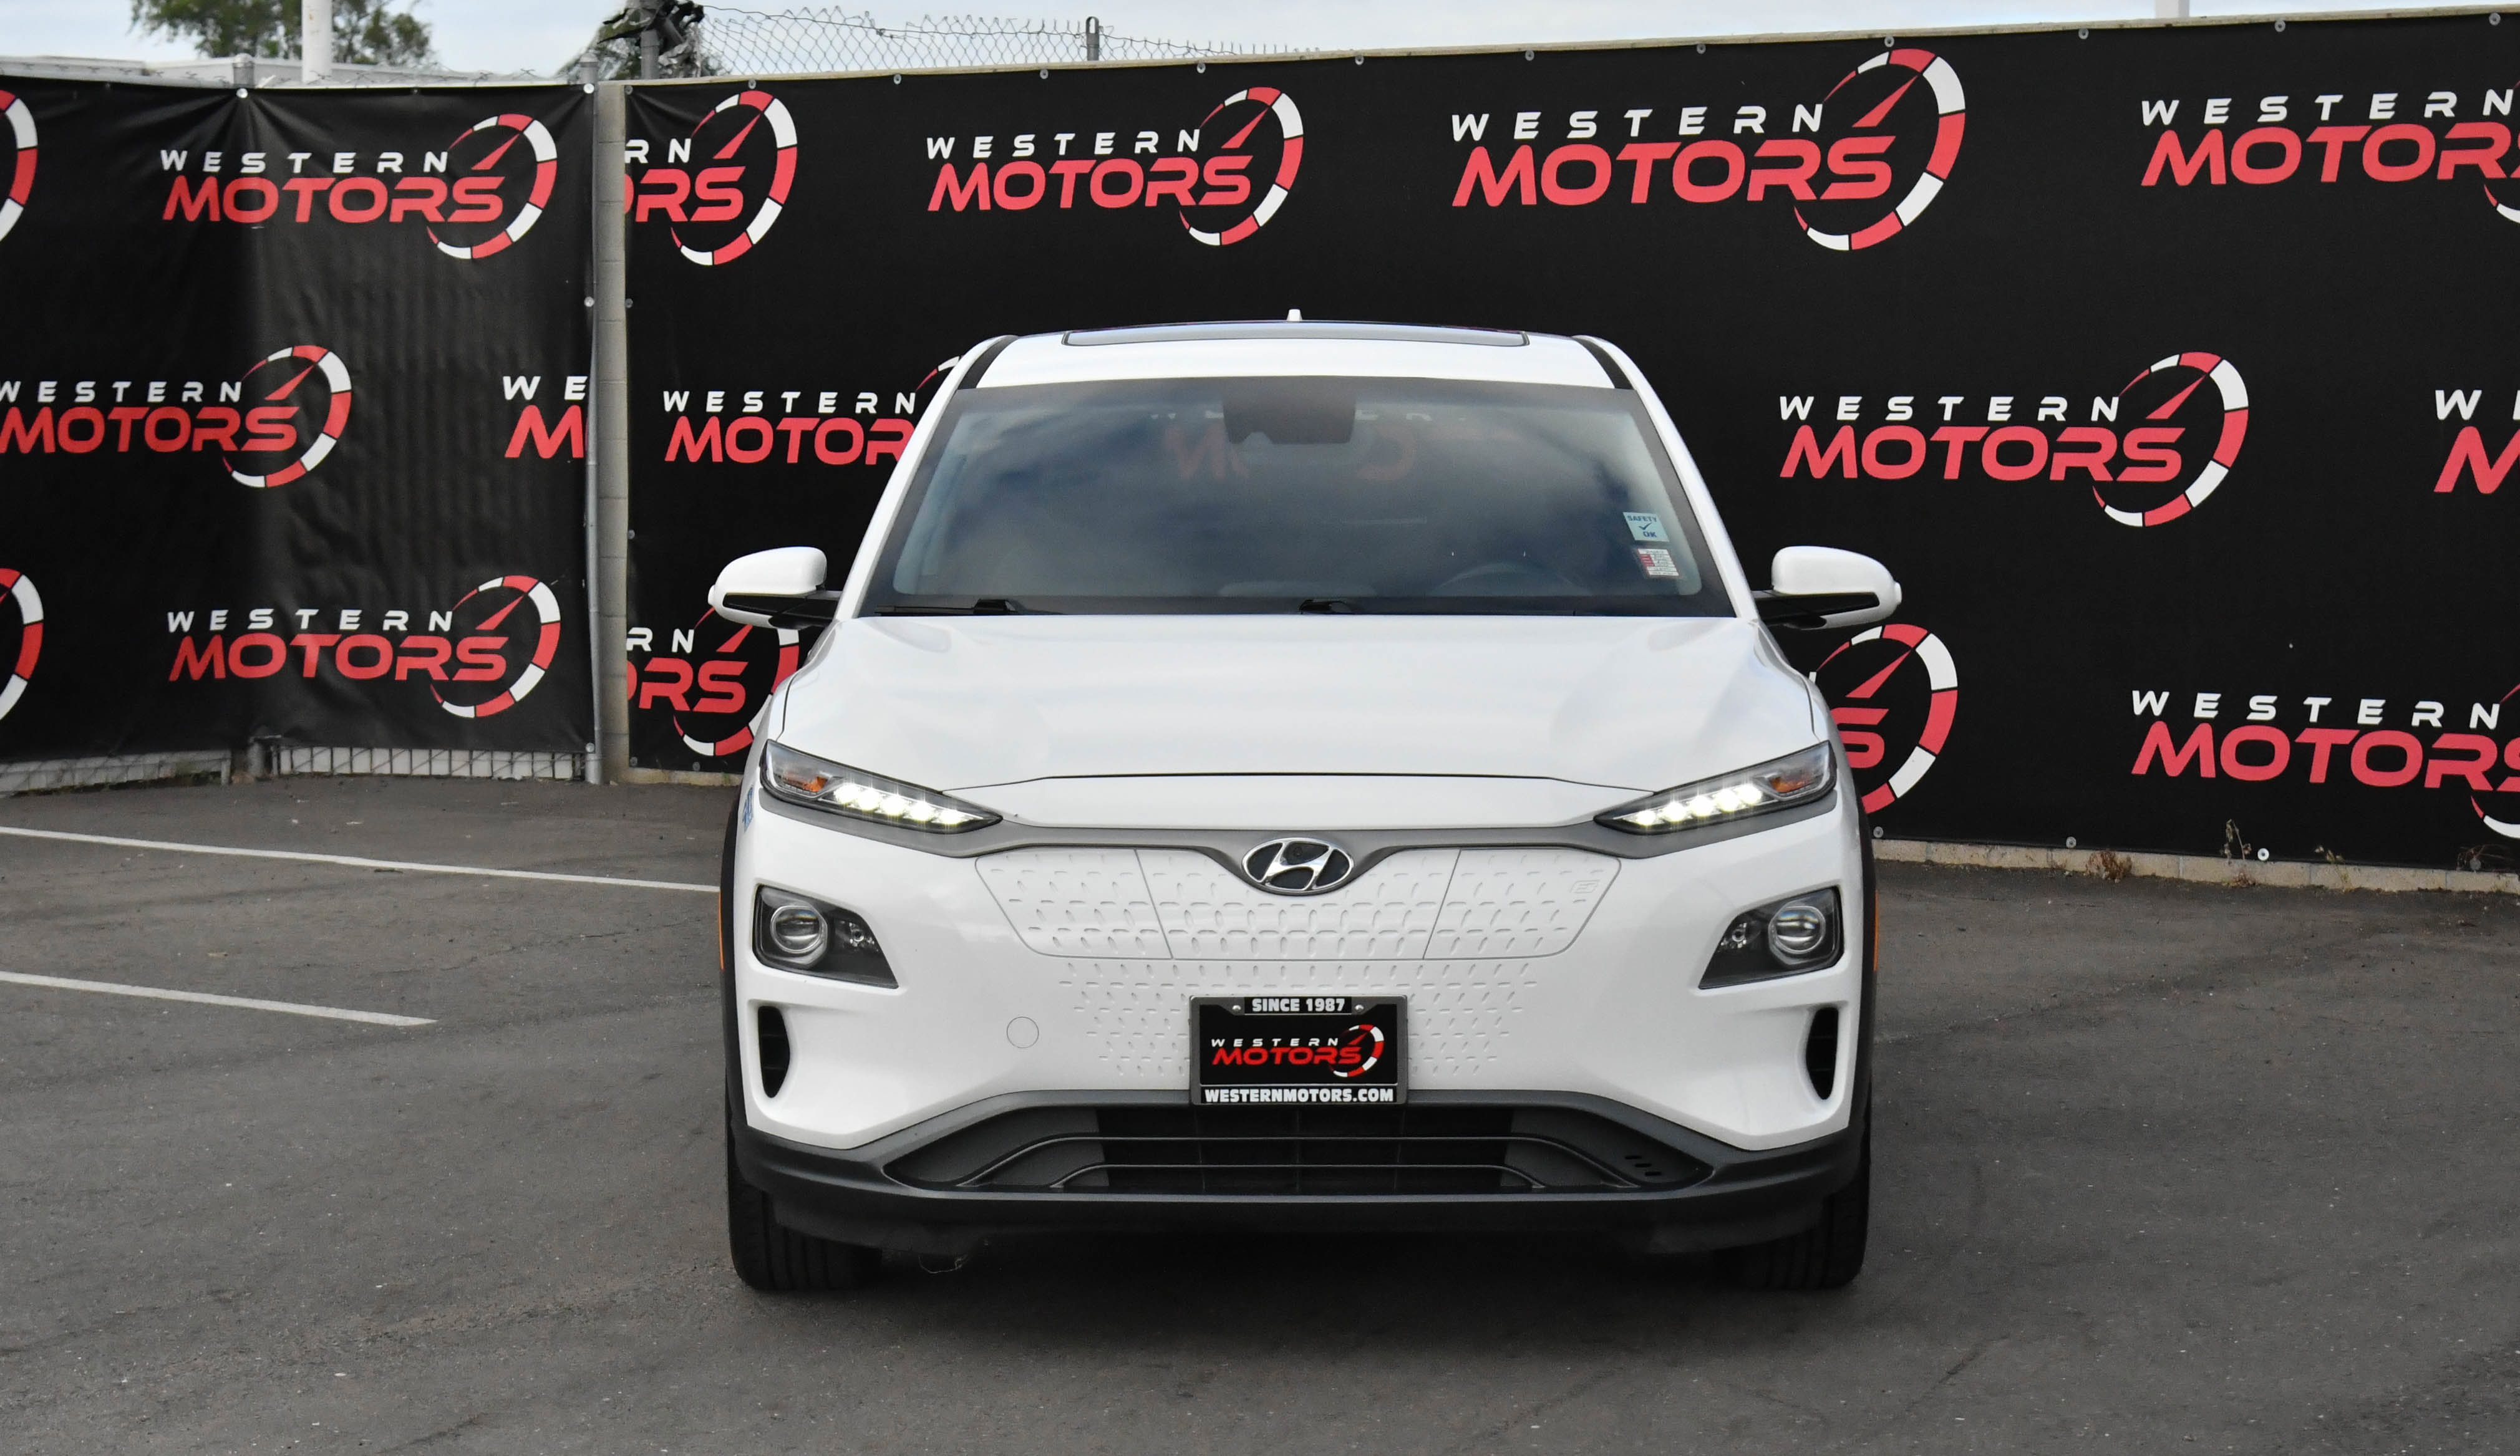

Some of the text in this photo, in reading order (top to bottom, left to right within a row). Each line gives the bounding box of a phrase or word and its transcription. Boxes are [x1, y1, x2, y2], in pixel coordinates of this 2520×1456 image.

[1452, 104, 1823, 142] WESTERN
[2142, 89, 2513, 125] WESTERN
[927, 129, 1199, 159] WESTERN
[2142, 122, 2520, 186] MOTOR
[161, 150, 448, 173] WESTERN
[1452, 136, 1896, 206] MOTORS
[163, 175, 504, 223] MOTORS
[928, 155, 1253, 211] MOTORS
[0, 381, 241, 402] WESTERN
[664, 391, 915, 414] WESTERN
[1780, 396, 2119, 422] WESTERN
[0, 407, 299, 454] MOTORS
[1780, 425, 2186, 482] MOTORS
[168, 609, 452, 632] WESTERN
[170, 633, 509, 681] MOTORS
[2133, 691, 2499, 729] WESTERN
[1253, 998, 1344, 1011] SINCE 1987
[1212, 1038, 1338, 1046] WESTERN
[1213, 1046, 1362, 1065] MOTORS
[1205, 1089, 1393, 1102] WESTERNMOTORS.COM
